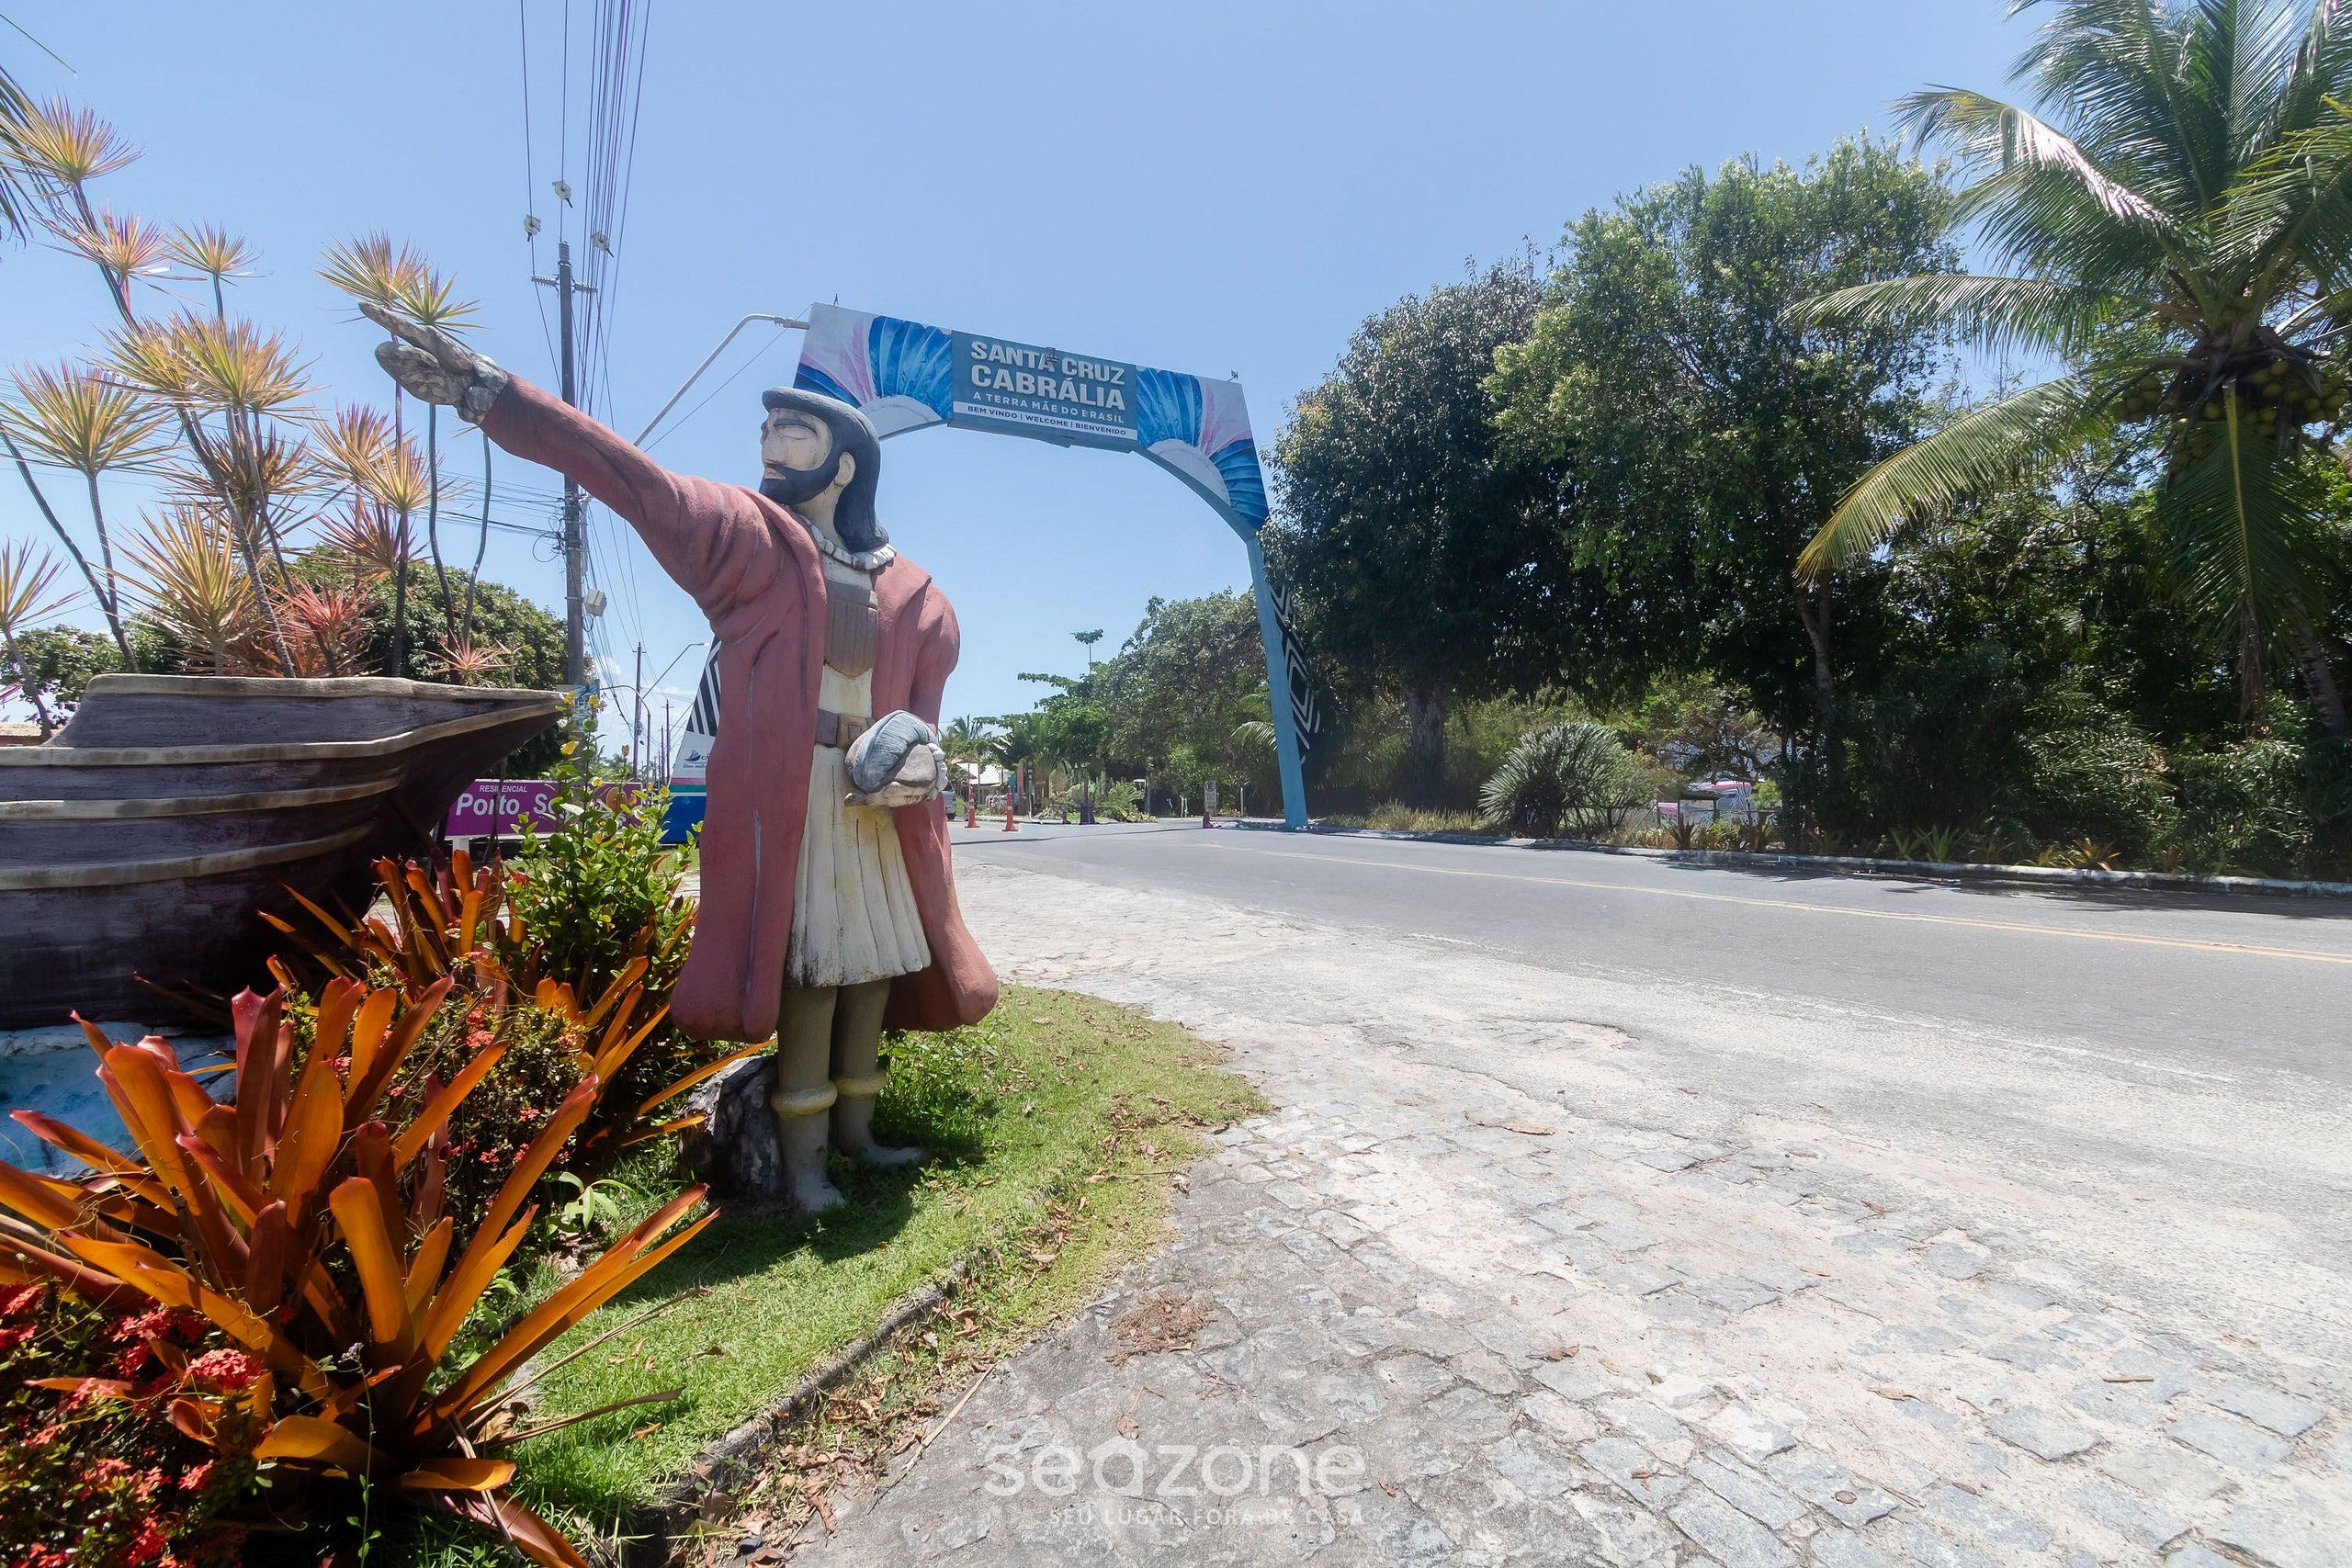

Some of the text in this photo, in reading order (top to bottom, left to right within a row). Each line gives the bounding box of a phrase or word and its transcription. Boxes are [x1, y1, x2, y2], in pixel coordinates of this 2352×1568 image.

[970, 341, 1125, 386] SANTA CRUZ
[970, 365, 1126, 412] CABRÁLIA
[967, 405, 1126, 435] BEM VINDO WELCOME BIENVENIDO
[972, 391, 1125, 423] A TERRA MÃE DO BRASIL
[479, 784, 528, 793] RESIENCIAL
